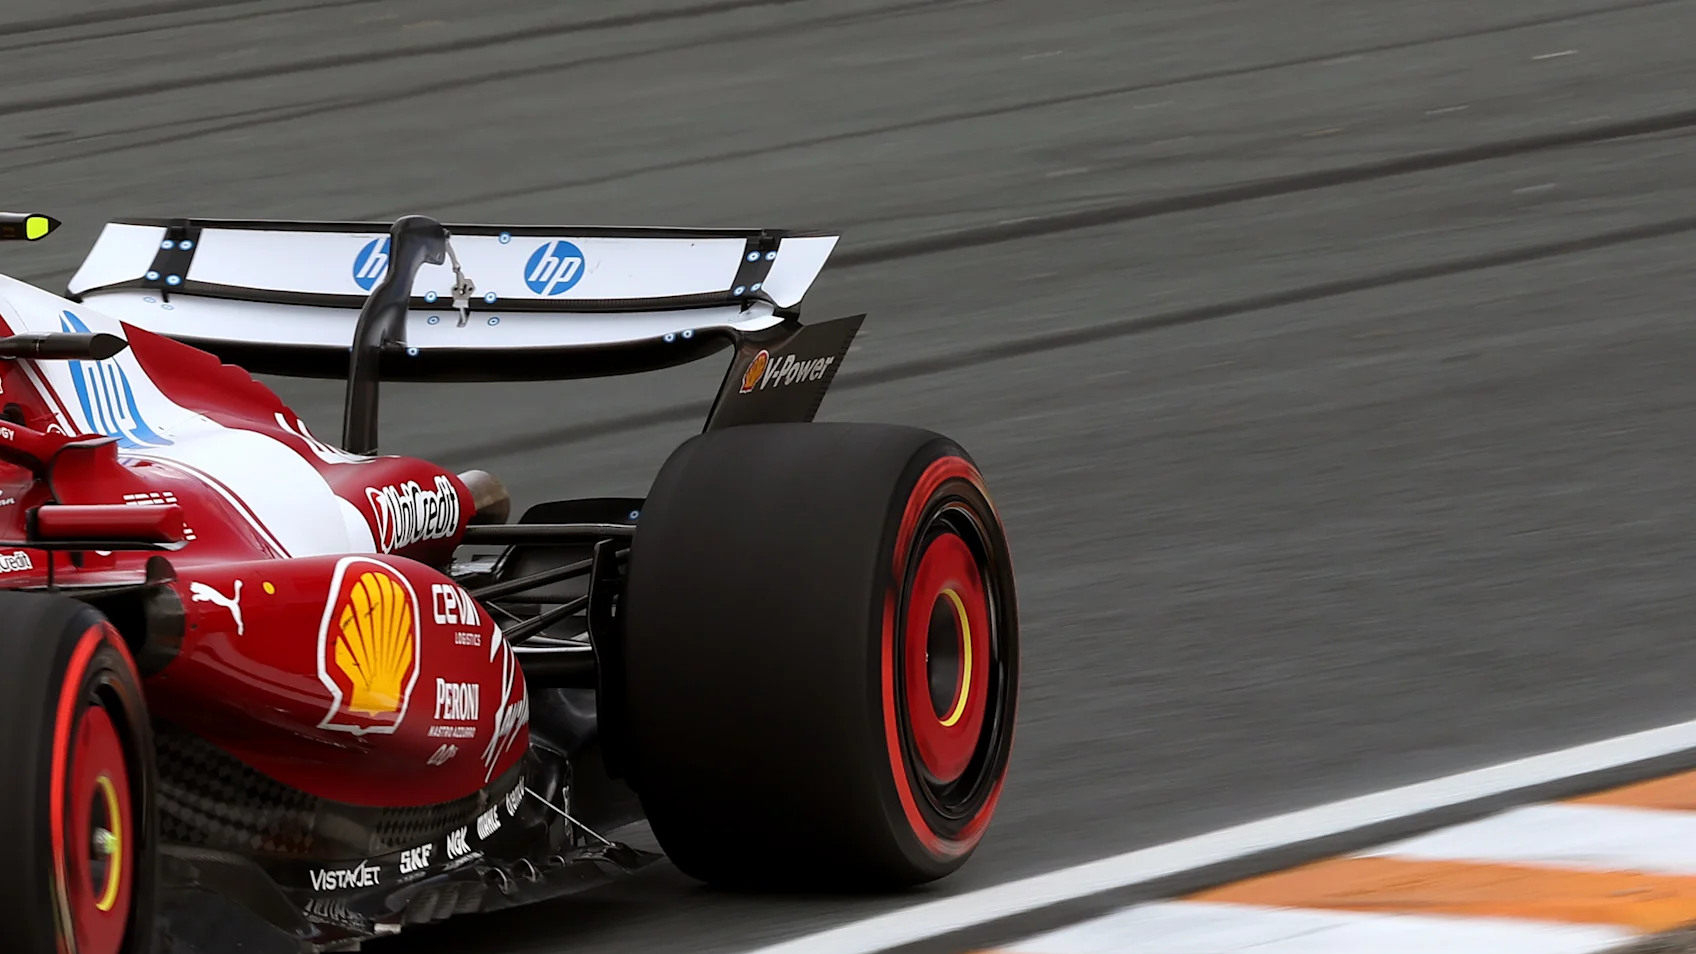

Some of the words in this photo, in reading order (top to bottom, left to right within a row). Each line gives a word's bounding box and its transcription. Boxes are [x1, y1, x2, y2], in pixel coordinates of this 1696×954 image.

[528, 240, 584, 296] hp
[761, 354, 835, 390] V-Power
[381, 475, 460, 550] UniCredit
[455, 632, 481, 646] LOGISTICS
[434, 678, 479, 721] PERONI
[399, 843, 433, 874] SKF
[447, 826, 472, 860] NGK
